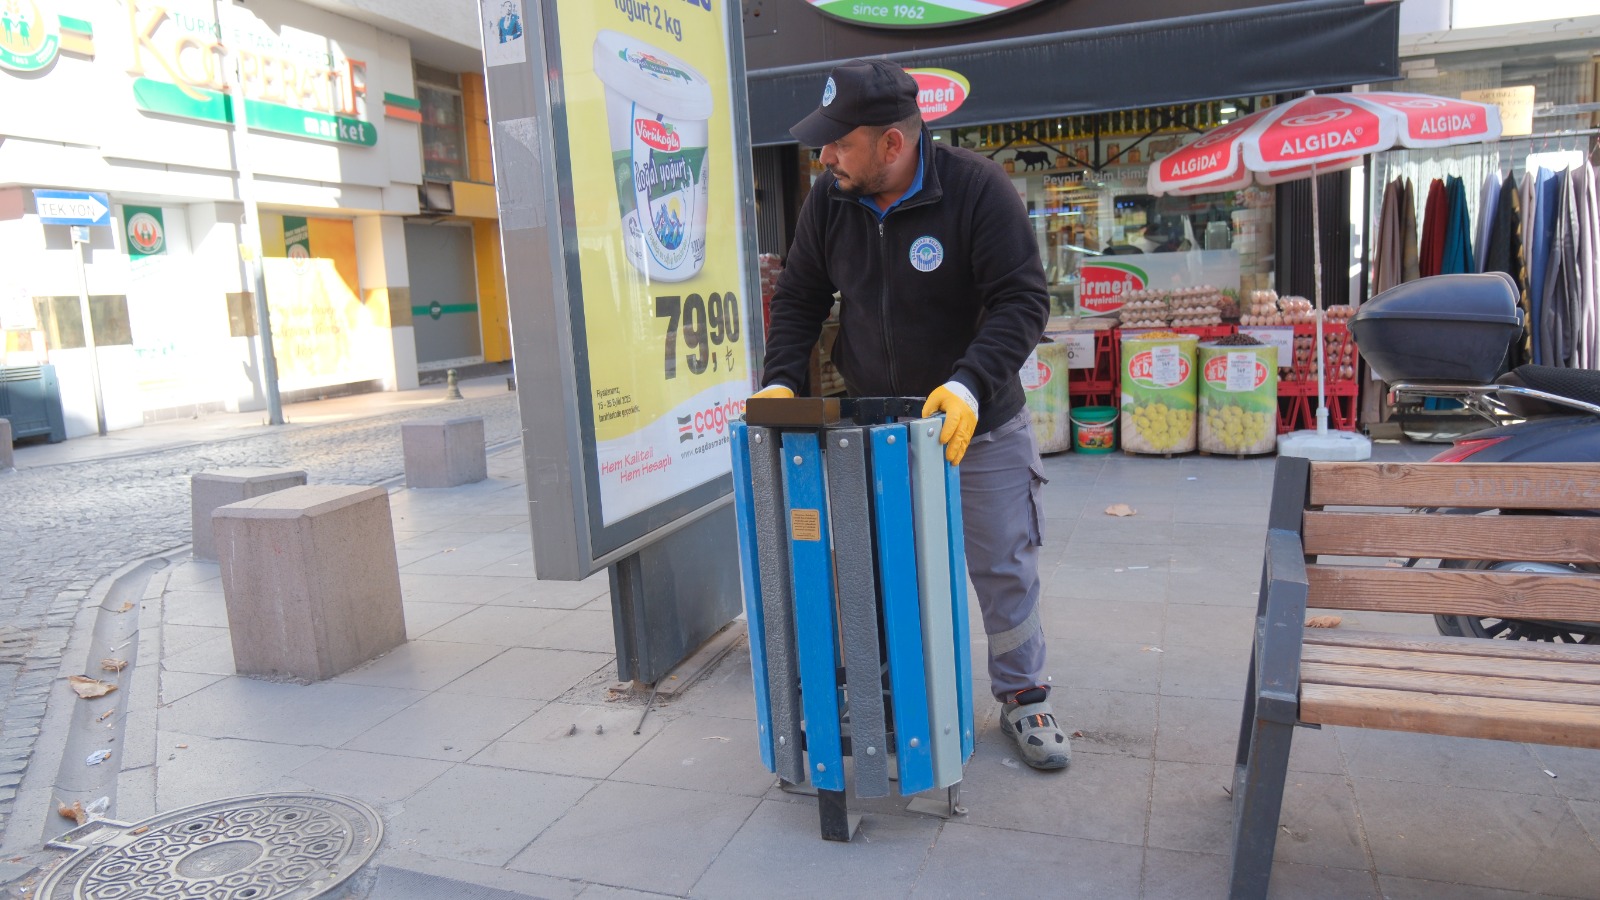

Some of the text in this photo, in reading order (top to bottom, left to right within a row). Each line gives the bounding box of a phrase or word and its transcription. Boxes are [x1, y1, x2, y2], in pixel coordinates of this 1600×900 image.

[653, 5, 662, 30] 2
[664, 9, 682, 42] kg
[852, 5, 925, 19] since 1962
[303, 117, 366, 142] market
[636, 119, 680, 150] Yörükoğlu
[635, 157, 658, 196] Doğal
[659, 156, 688, 191] yoğurt
[1043, 174, 1080, 187] Peynir
[42, 203, 67, 216] TEK
[601, 446, 654, 475] Hem Kaliteli
[620, 454, 672, 483] Hem Hesaplı
